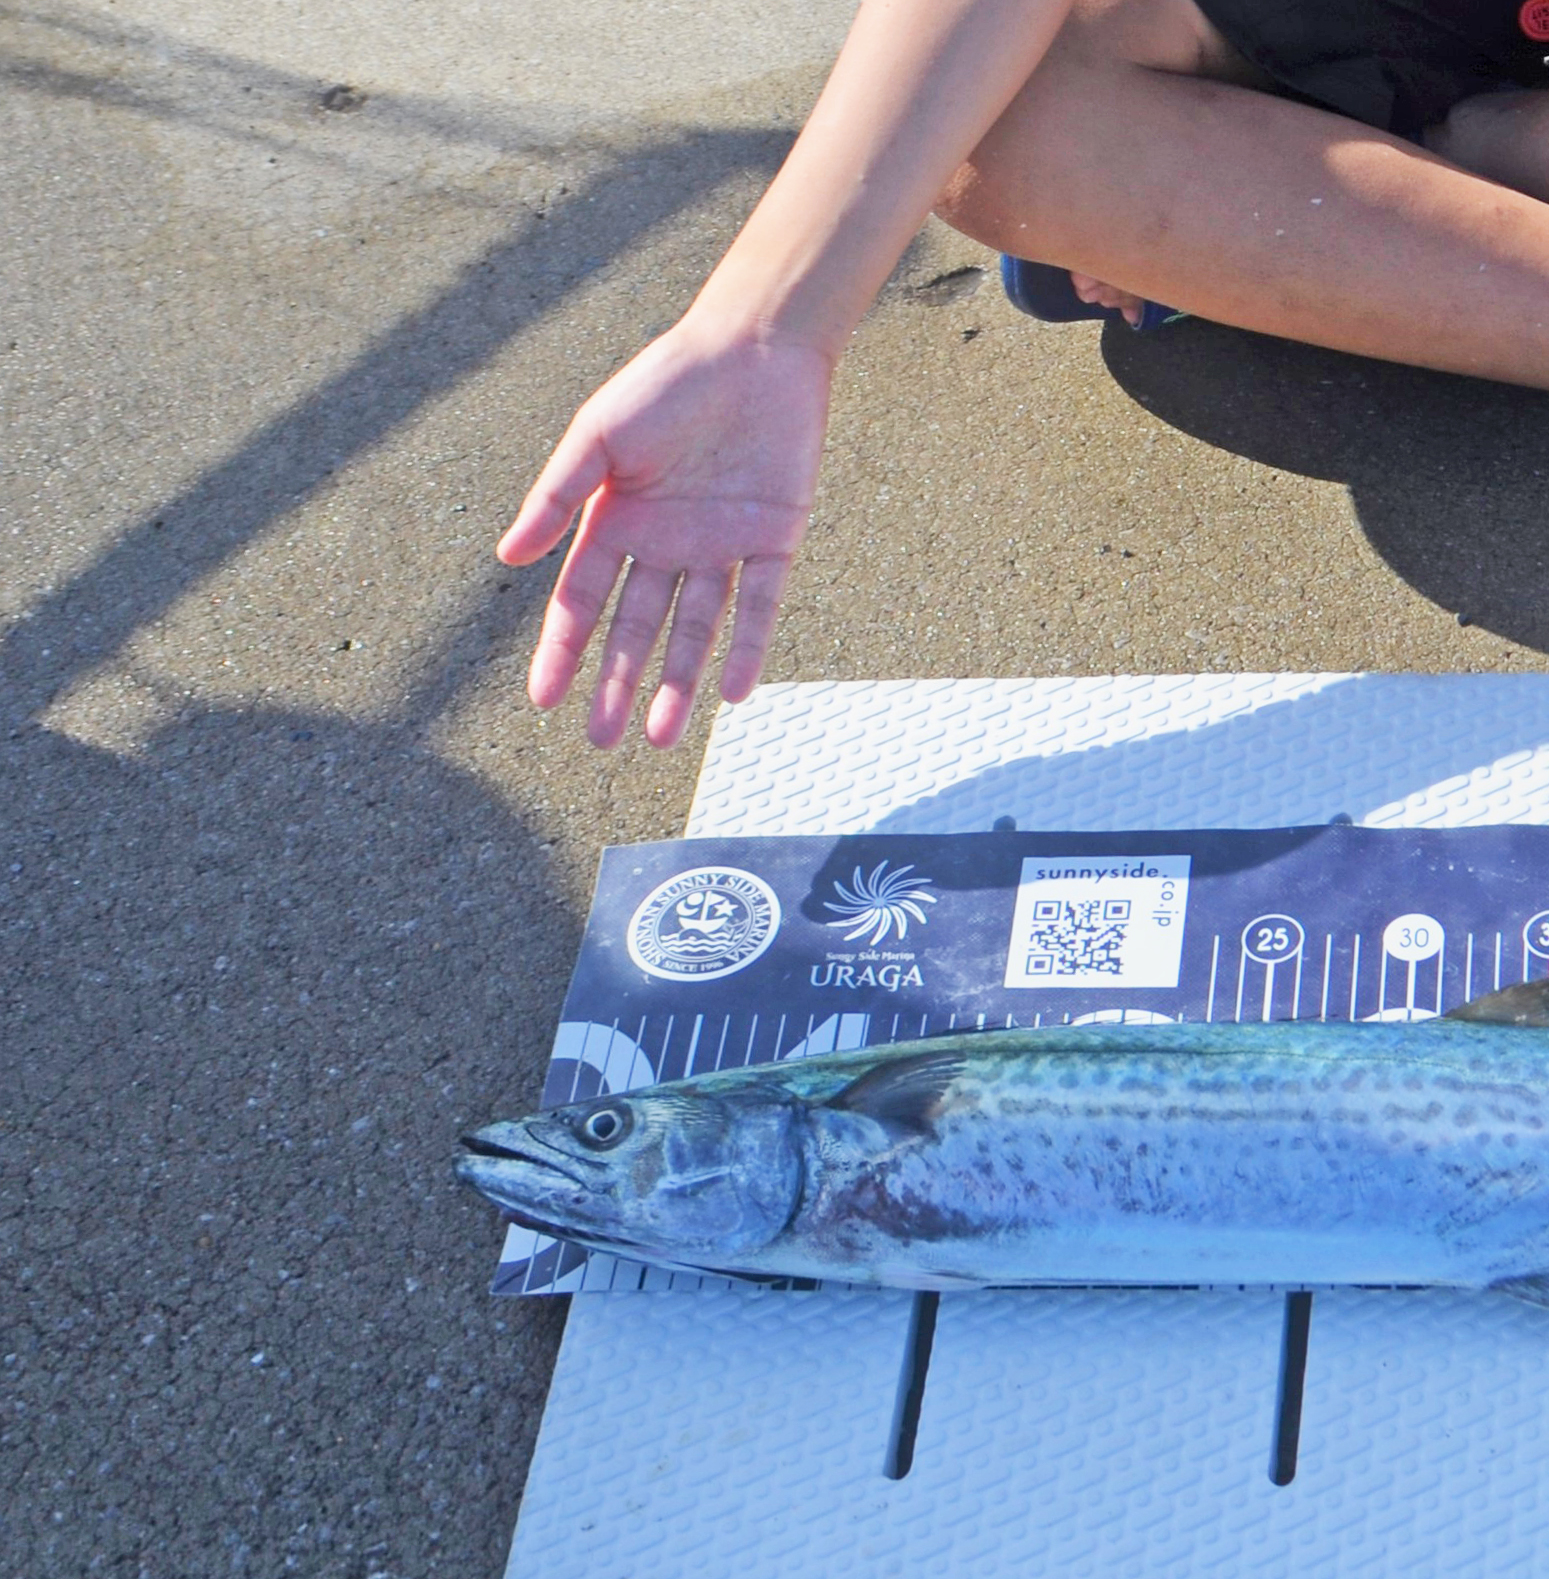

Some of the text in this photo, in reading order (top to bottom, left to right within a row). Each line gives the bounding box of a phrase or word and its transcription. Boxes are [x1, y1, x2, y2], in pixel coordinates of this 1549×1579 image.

[636, 873, 772, 966] SHONAN SUNNY SIDE MARINA
[1256, 927, 1290, 952] 25
[1399, 927, 1430, 948] 30
[661, 959, 698, 972] SINCE
[858, 949, 881, 961] Side
[810, 961, 925, 992] URAGA
